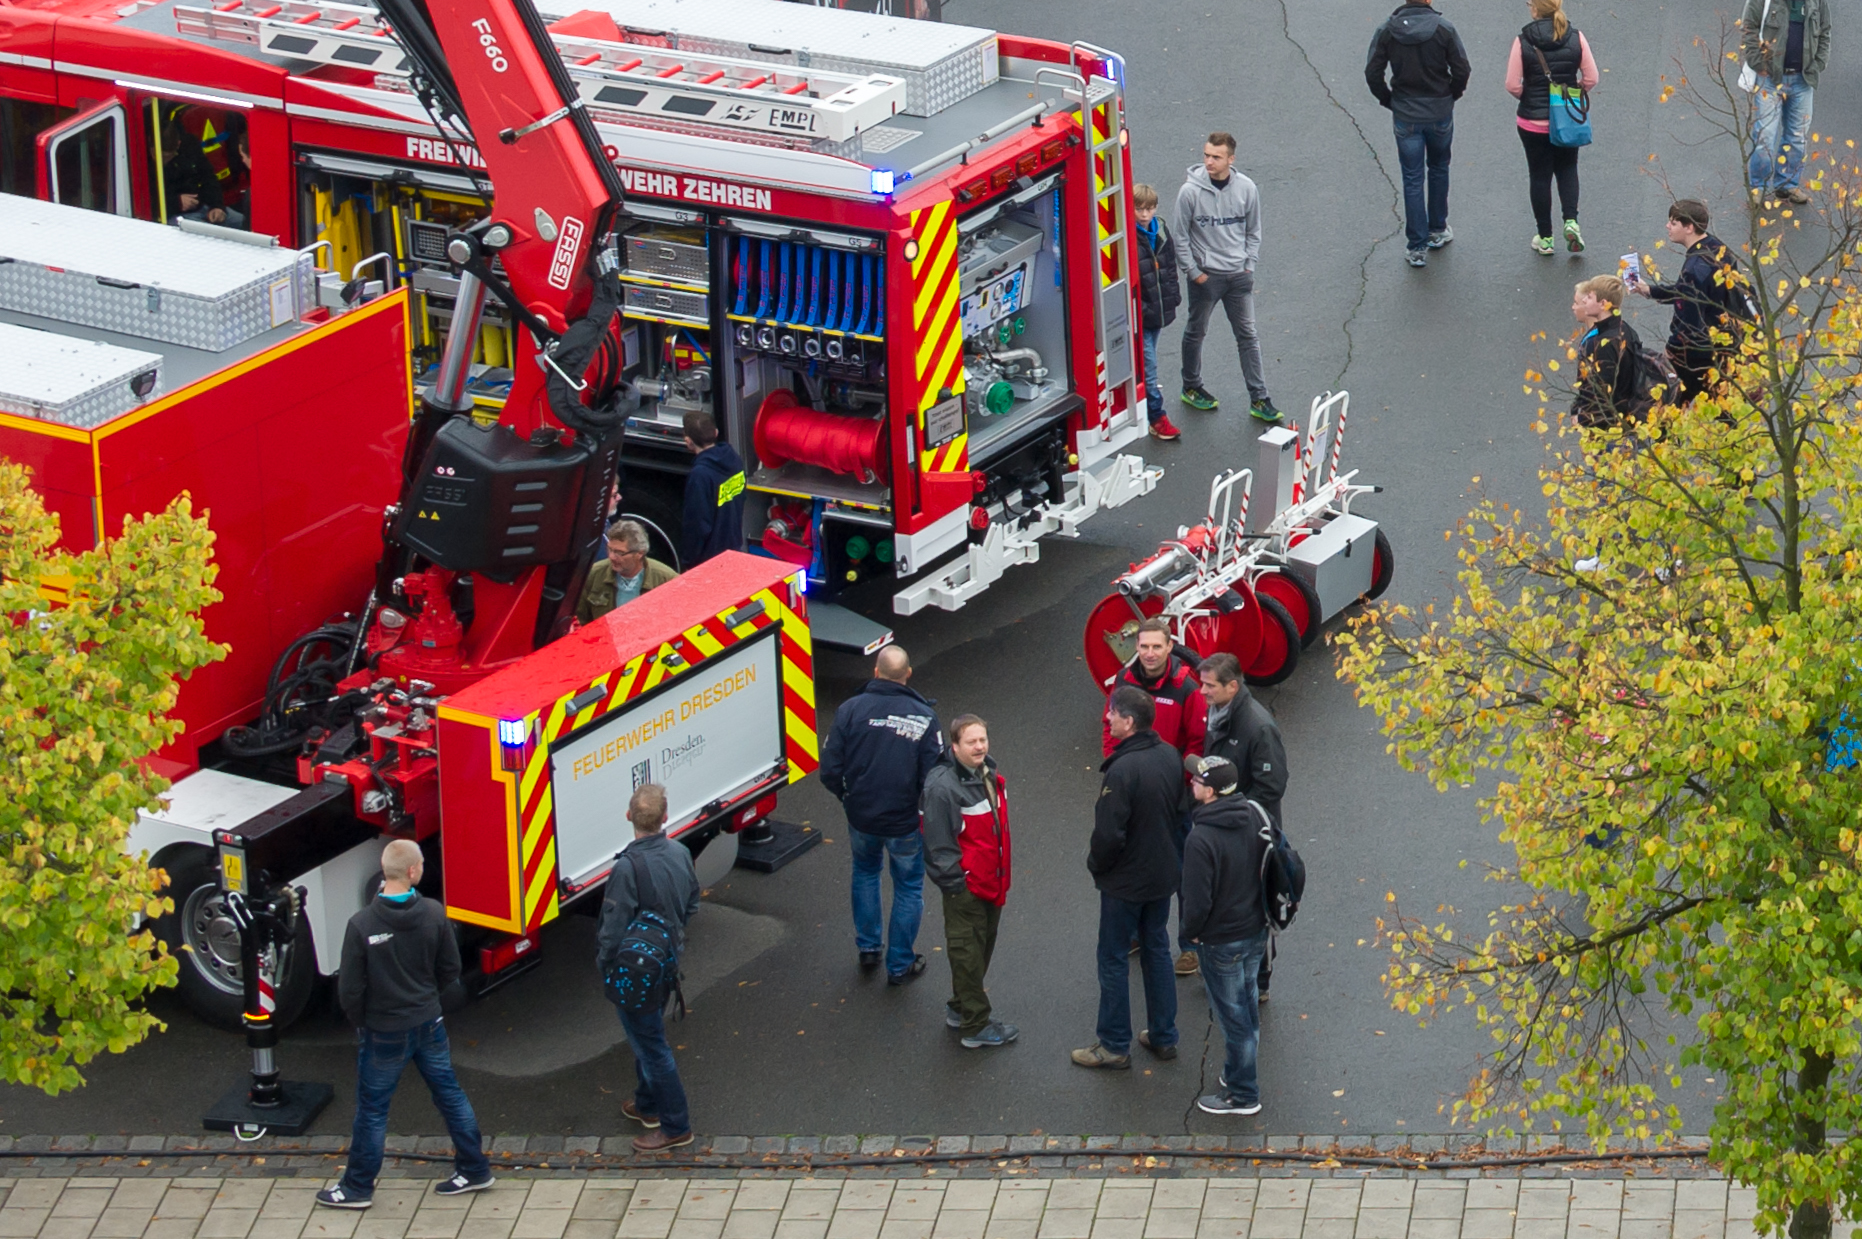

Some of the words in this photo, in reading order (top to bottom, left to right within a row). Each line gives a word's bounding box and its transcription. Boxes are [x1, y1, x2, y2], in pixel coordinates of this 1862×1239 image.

[472, 17, 508, 74] F660
[768, 108, 816, 133] EMPL
[683, 178, 772, 211] ZEHREN
[553, 222, 580, 285] FASSI
[571, 711, 677, 781] FEUERWEHR
[680, 663, 758, 717] DRESDEN
[662, 733, 706, 765] Dresden.
